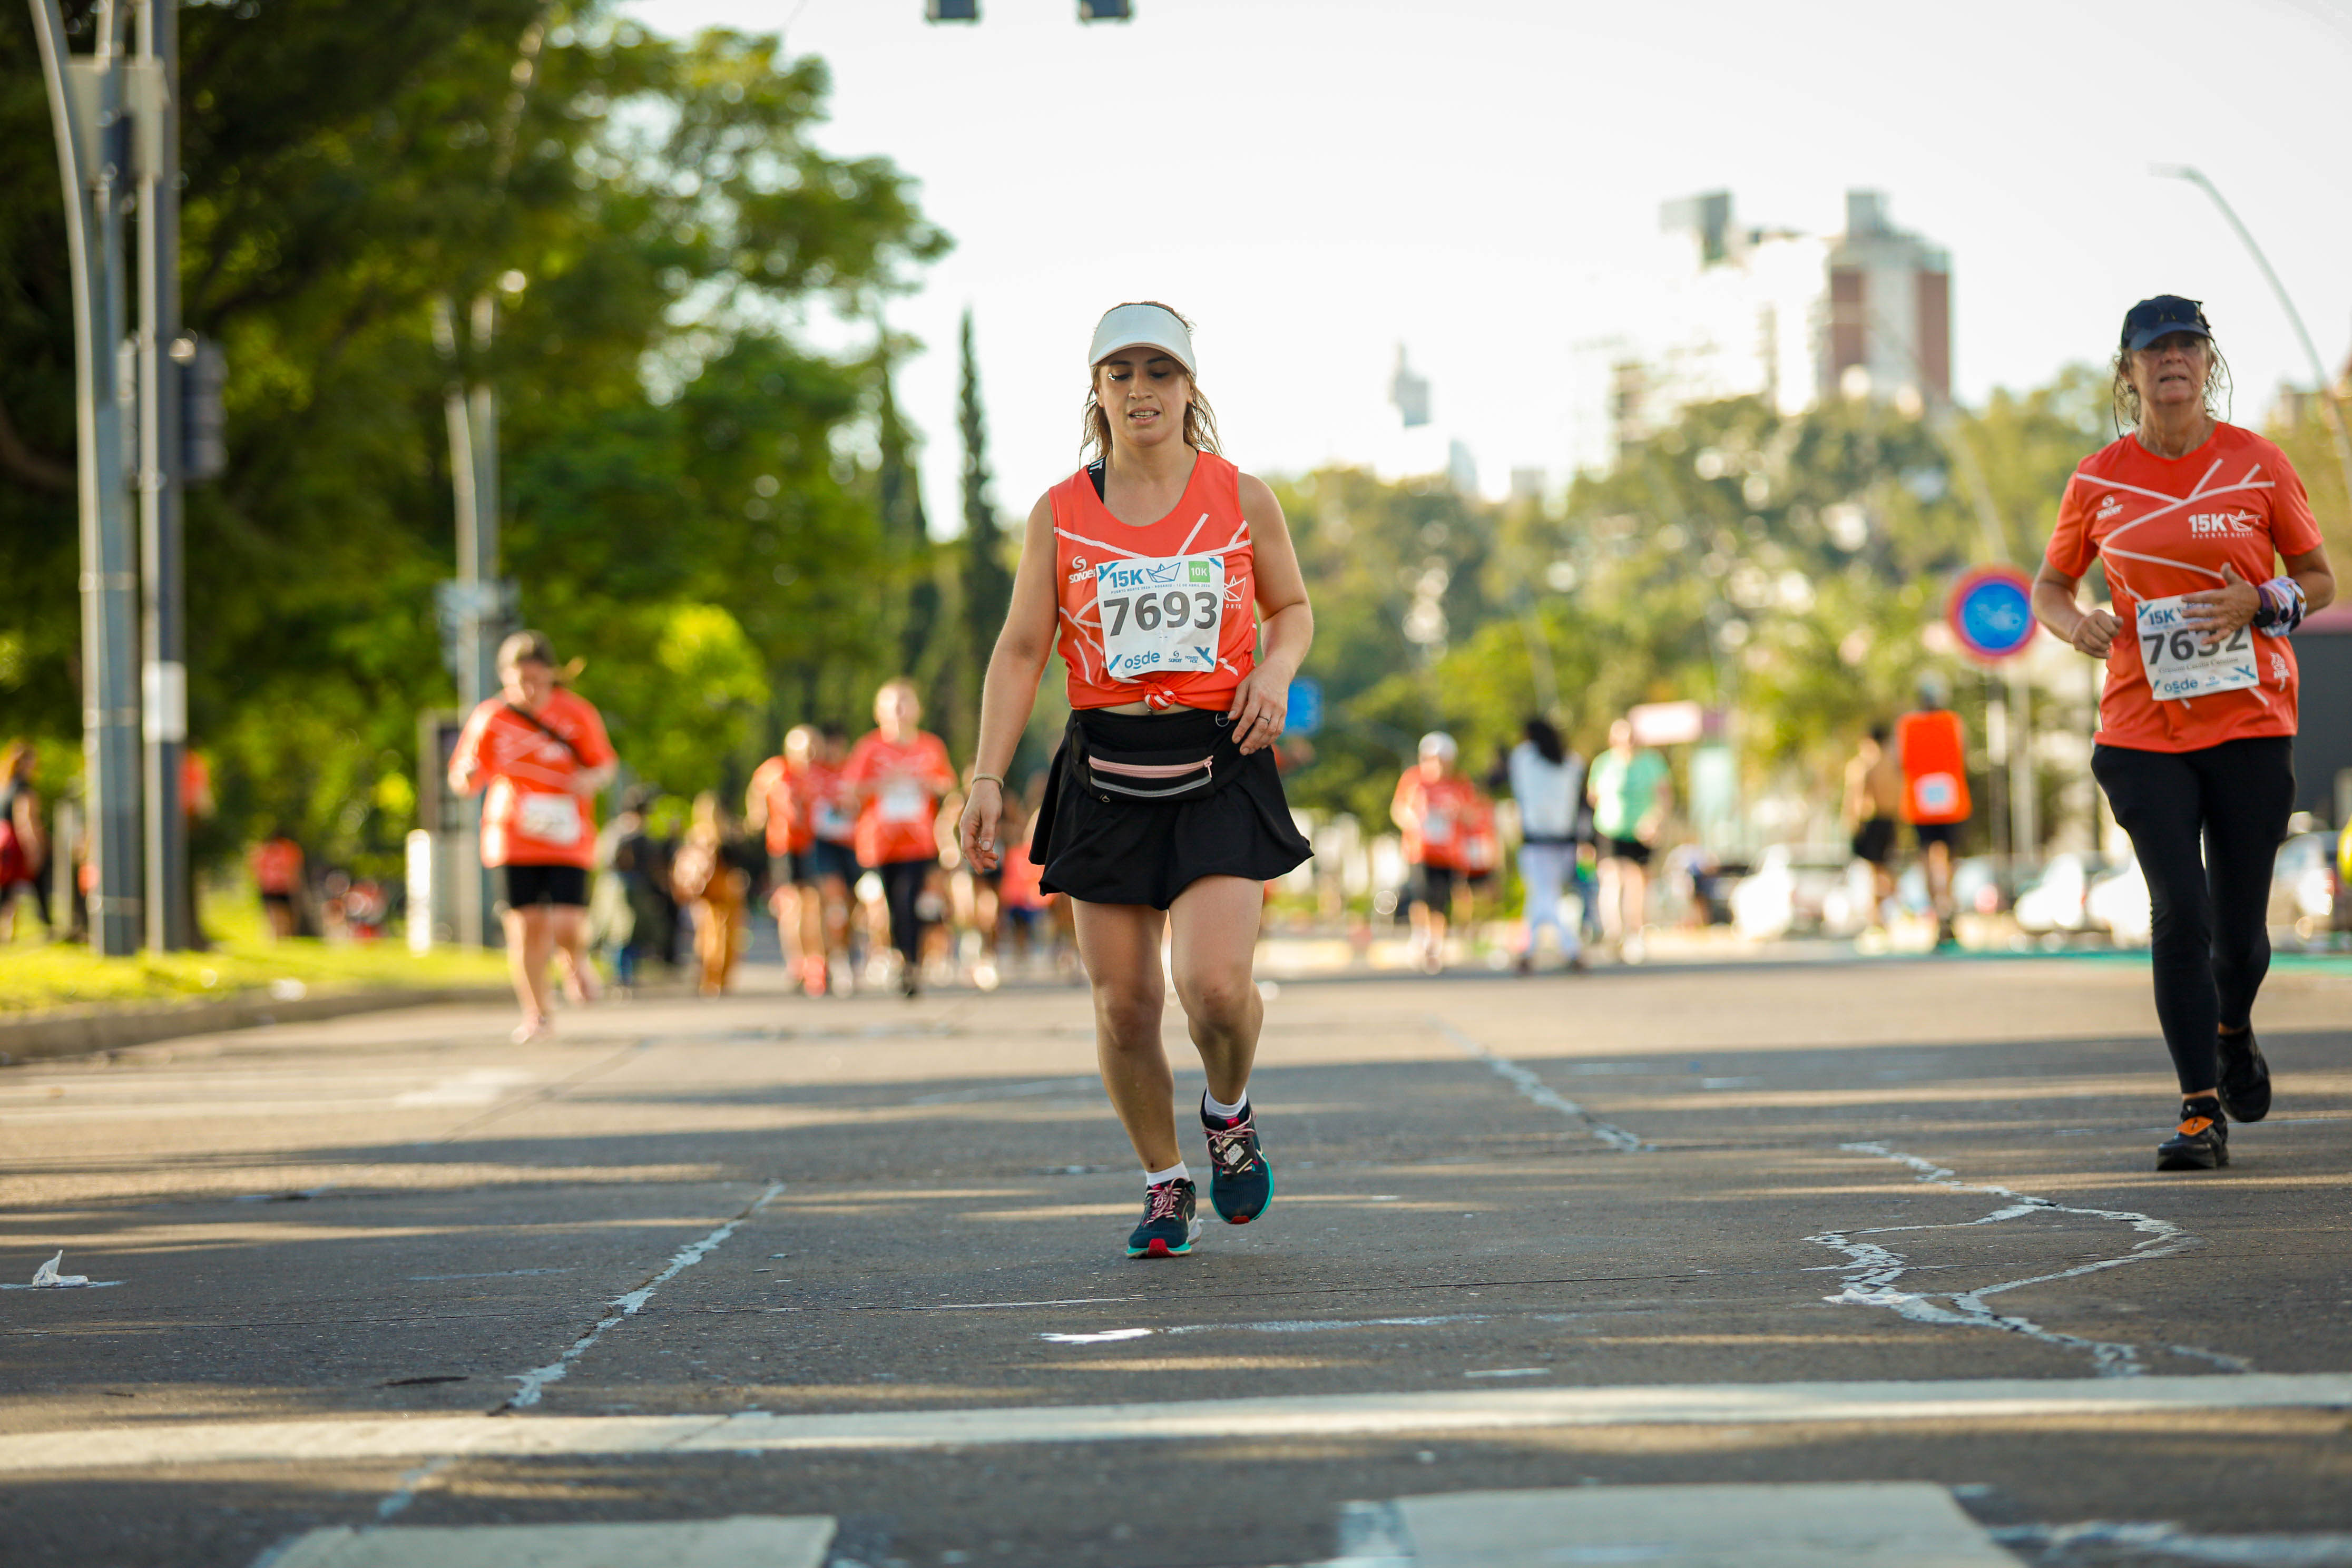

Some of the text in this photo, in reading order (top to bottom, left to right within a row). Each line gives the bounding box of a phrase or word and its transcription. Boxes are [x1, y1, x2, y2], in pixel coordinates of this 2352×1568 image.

[2188, 513, 2227, 533] 15K
[1110, 569, 1144, 588] 15K
[1190, 567, 1208, 576] 10K
[1103, 591, 1218, 637] 7693
[2149, 608, 2176, 625] 15K
[2142, 628, 2248, 665] 7632
[1125, 650, 1161, 669] osde
[2164, 678, 2198, 693] osde
